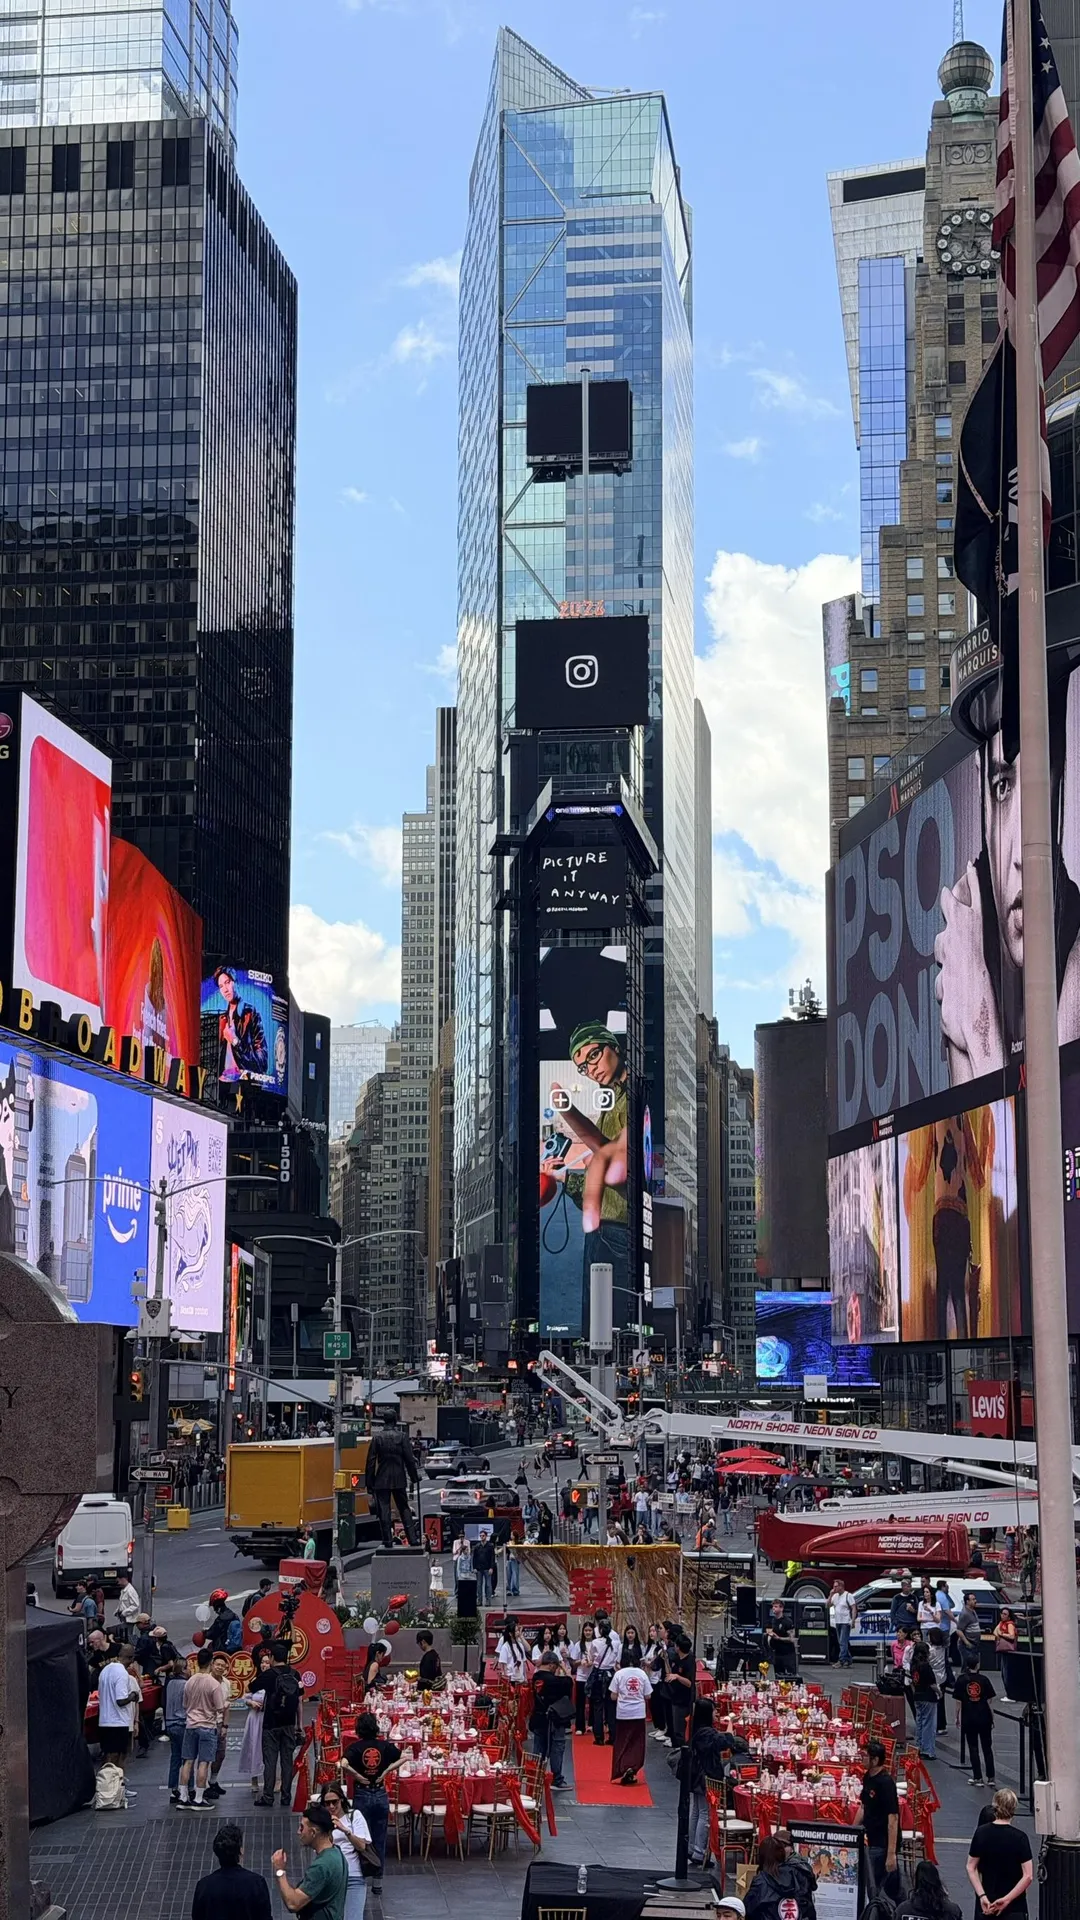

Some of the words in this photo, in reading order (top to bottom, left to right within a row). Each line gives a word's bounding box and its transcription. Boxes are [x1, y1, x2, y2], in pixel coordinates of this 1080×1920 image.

[957, 628, 990, 662] MARRIO
[958, 644, 999, 682] MARQUIS
[0, 745, 10, 759] G
[900, 761, 925, 788] MARRIOTT
[900, 779, 922, 804] MARQUIS
[570, 806, 590, 814] times
[543, 852, 608, 869] PICTURE
[551, 888, 620, 905] ANYWAY
[247, 969, 273, 984] SEIKO
[18, 988, 208, 1099] BROADWAY
[280, 1133, 290, 1182] 1500
[103, 1167, 142, 1213] prime
[727, 1419, 763, 1431] NORTH
[765, 1422, 800, 1434] SHORE
[803, 1425, 834, 1436] NEON
[835, 1428, 860, 1439] SIGN
[862, 1430, 877, 1440] CO
[915, 1514, 945, 1524] NEON
[947, 1513, 972, 1523] SIGN
[974, 1511, 989, 1522] CO
[791, 1829, 826, 1840] MIDNIGHT
[827, 1832, 858, 1843] MOMENT
